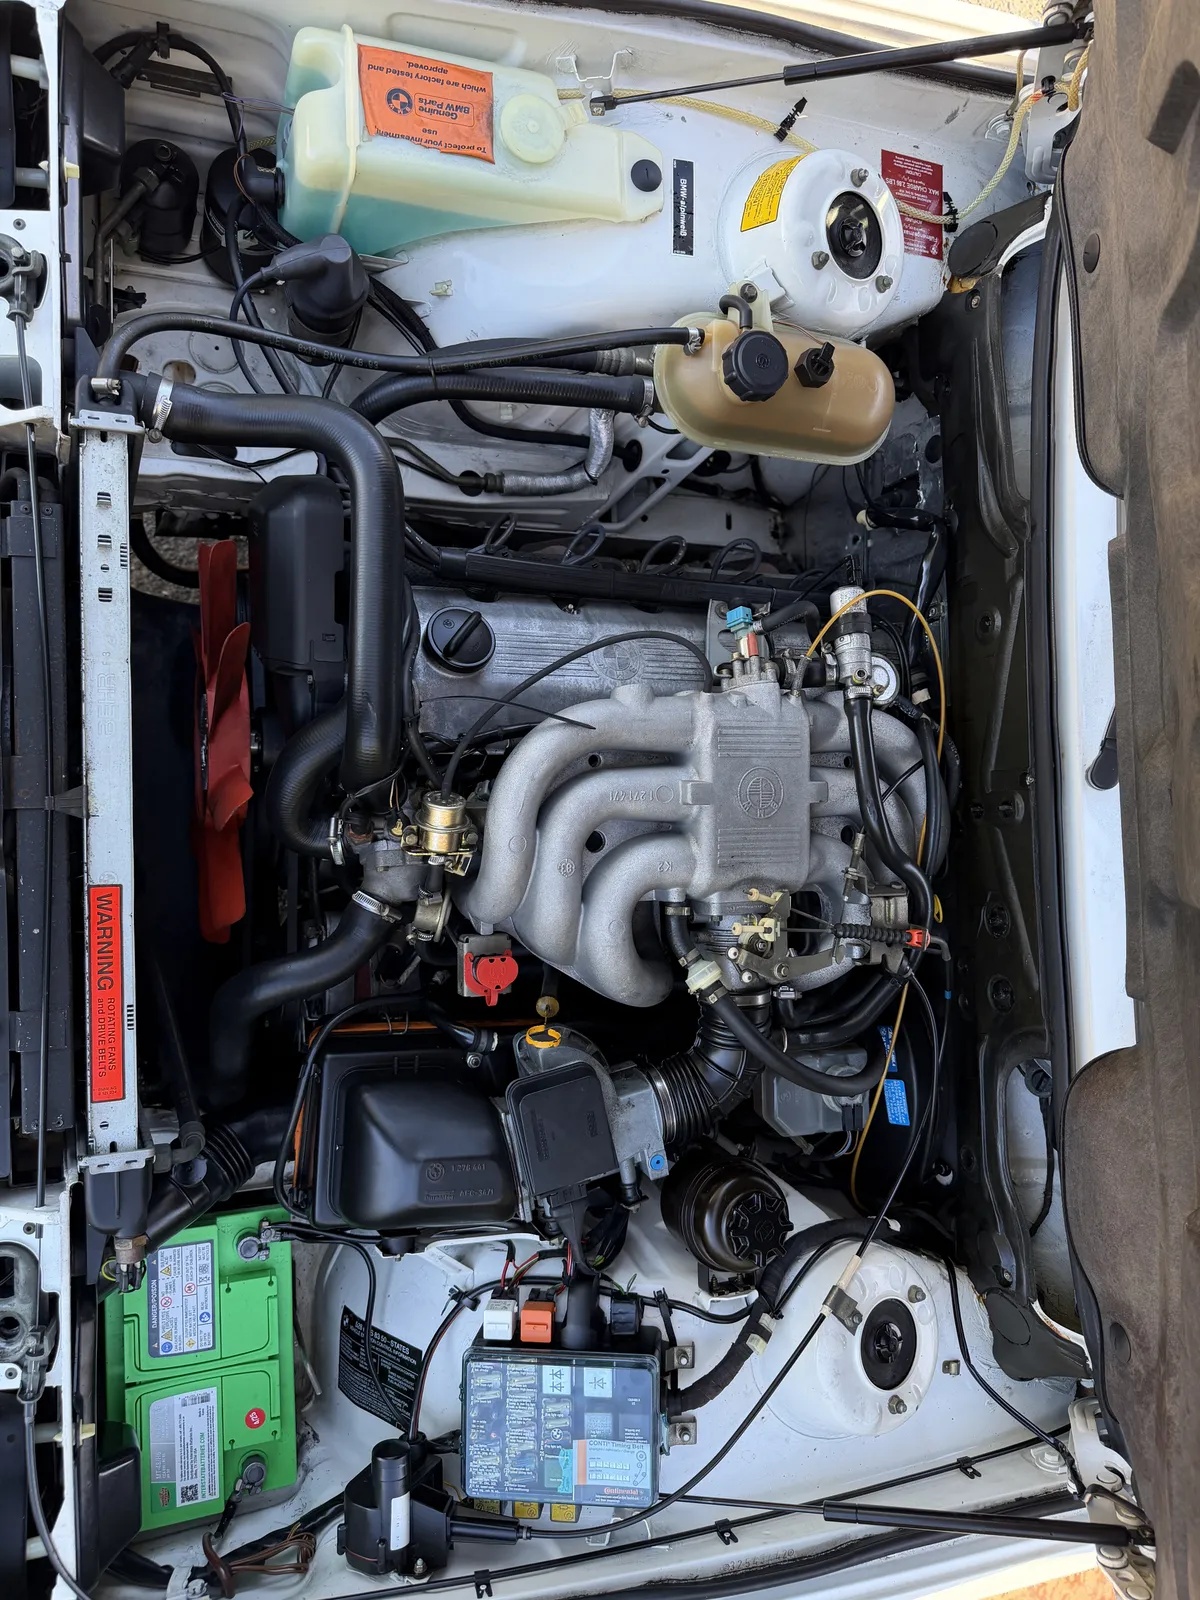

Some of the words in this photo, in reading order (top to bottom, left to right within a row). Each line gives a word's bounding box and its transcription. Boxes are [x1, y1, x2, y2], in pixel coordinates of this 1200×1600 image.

[368, 64, 384, 73] and
[386, 68, 413, 79] tested
[407, 62, 448, 75] approved.
[415, 74, 444, 85] factory
[446, 80, 459, 88] are
[462, 84, 486, 93] which
[418, 98, 444, 109] Parts
[446, 103, 470, 114] BMW
[418, 106, 458, 120] Genuine
[425, 138, 443, 148] your
[445, 143, 475, 151] protect
[906, 183, 927, 193] CHARGE
[928, 187, 939, 195] MAX
[323, 350, 346, 362] BMW
[629, 791, 646, 801] 271
[650, 791, 654, 801] 1
[97, 893, 114, 991] WARNING
[97, 998, 105, 1015] and
[107, 998, 116, 1043] ROTATING
[98, 1017, 106, 1046] DRIVE
[98, 1048, 106, 1078] BELTS
[108, 1047, 116, 1070] FANS
[612, 1442, 631, 1450] Timing
[604, 1487, 638, 1495] Continental
